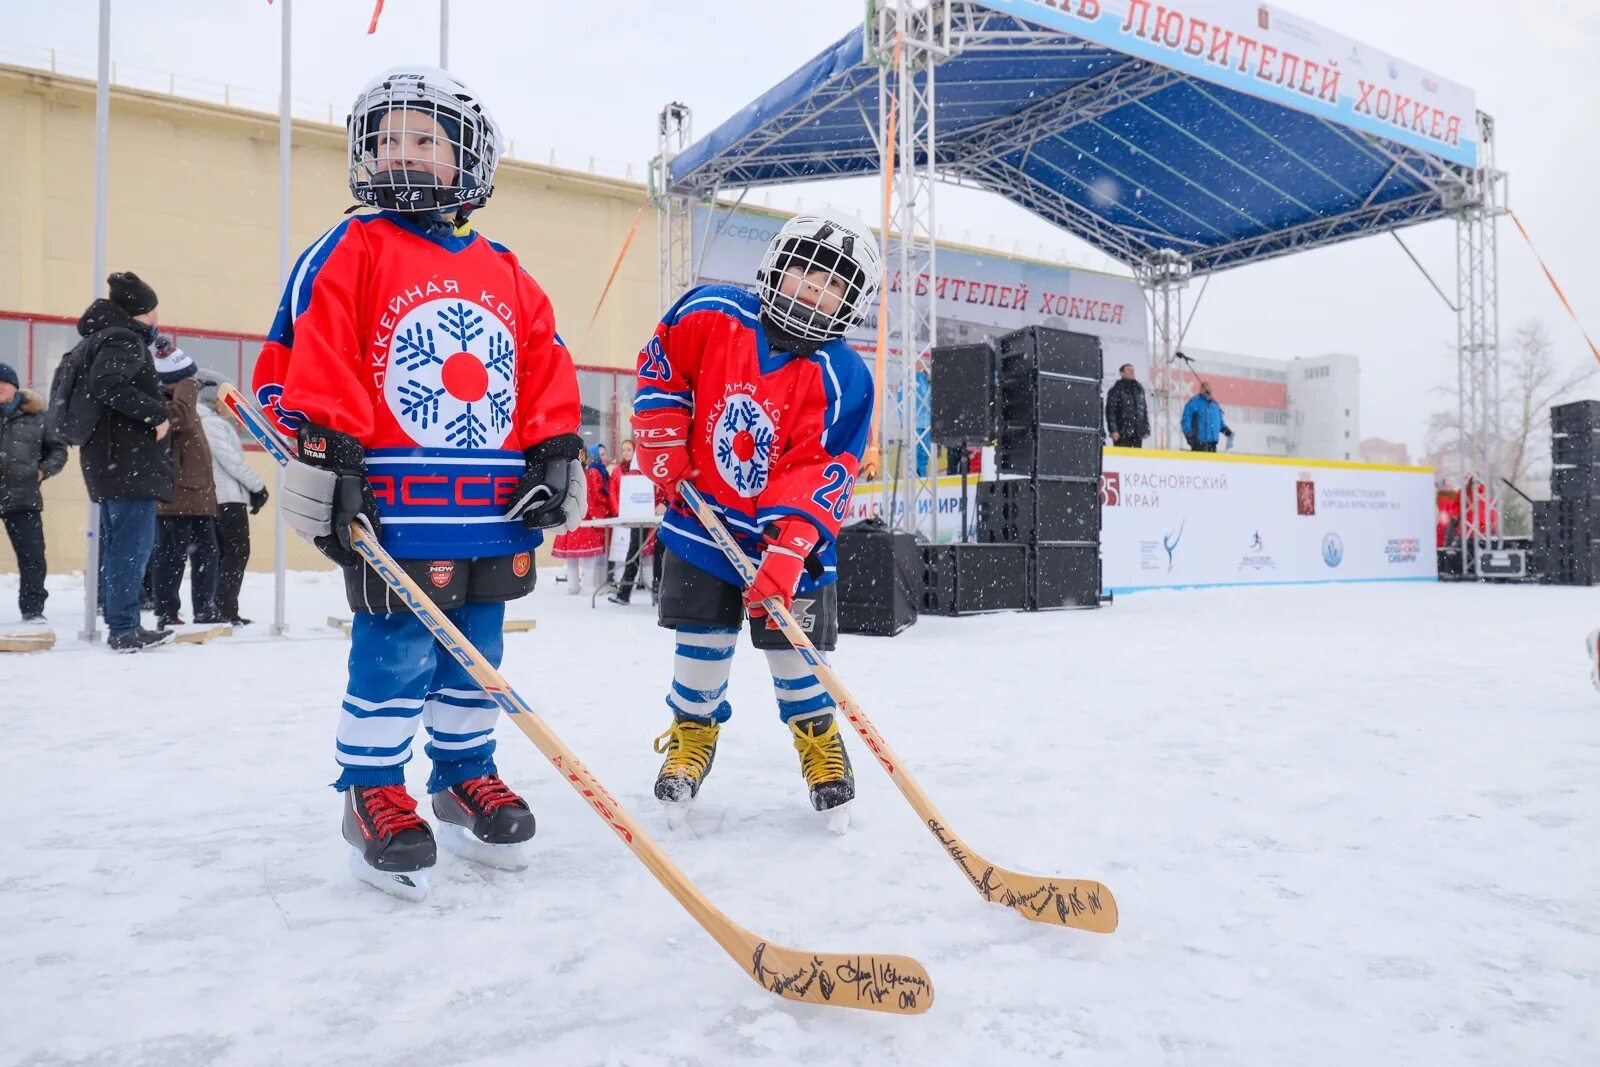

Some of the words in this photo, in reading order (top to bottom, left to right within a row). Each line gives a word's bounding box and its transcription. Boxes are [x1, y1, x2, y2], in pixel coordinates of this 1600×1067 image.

[1121, 0, 1341, 103] ЛЮБИТЕЛЕЙ
[1354, 79, 1462, 146] ХОККЕЯ
[1039, 292, 1124, 325] ХОККЕЯ
[638, 334, 672, 382] 28
[303, 448, 326, 459] TITAN
[810, 462, 855, 522] 28
[1124, 472, 1228, 490] КРАСНОЯРСКИЙ
[1125, 491, 1160, 508] КРАЙ
[354, 540, 476, 668] PIONEER
[848, 709, 895, 775] TISA
[567, 767, 633, 845] TISA
